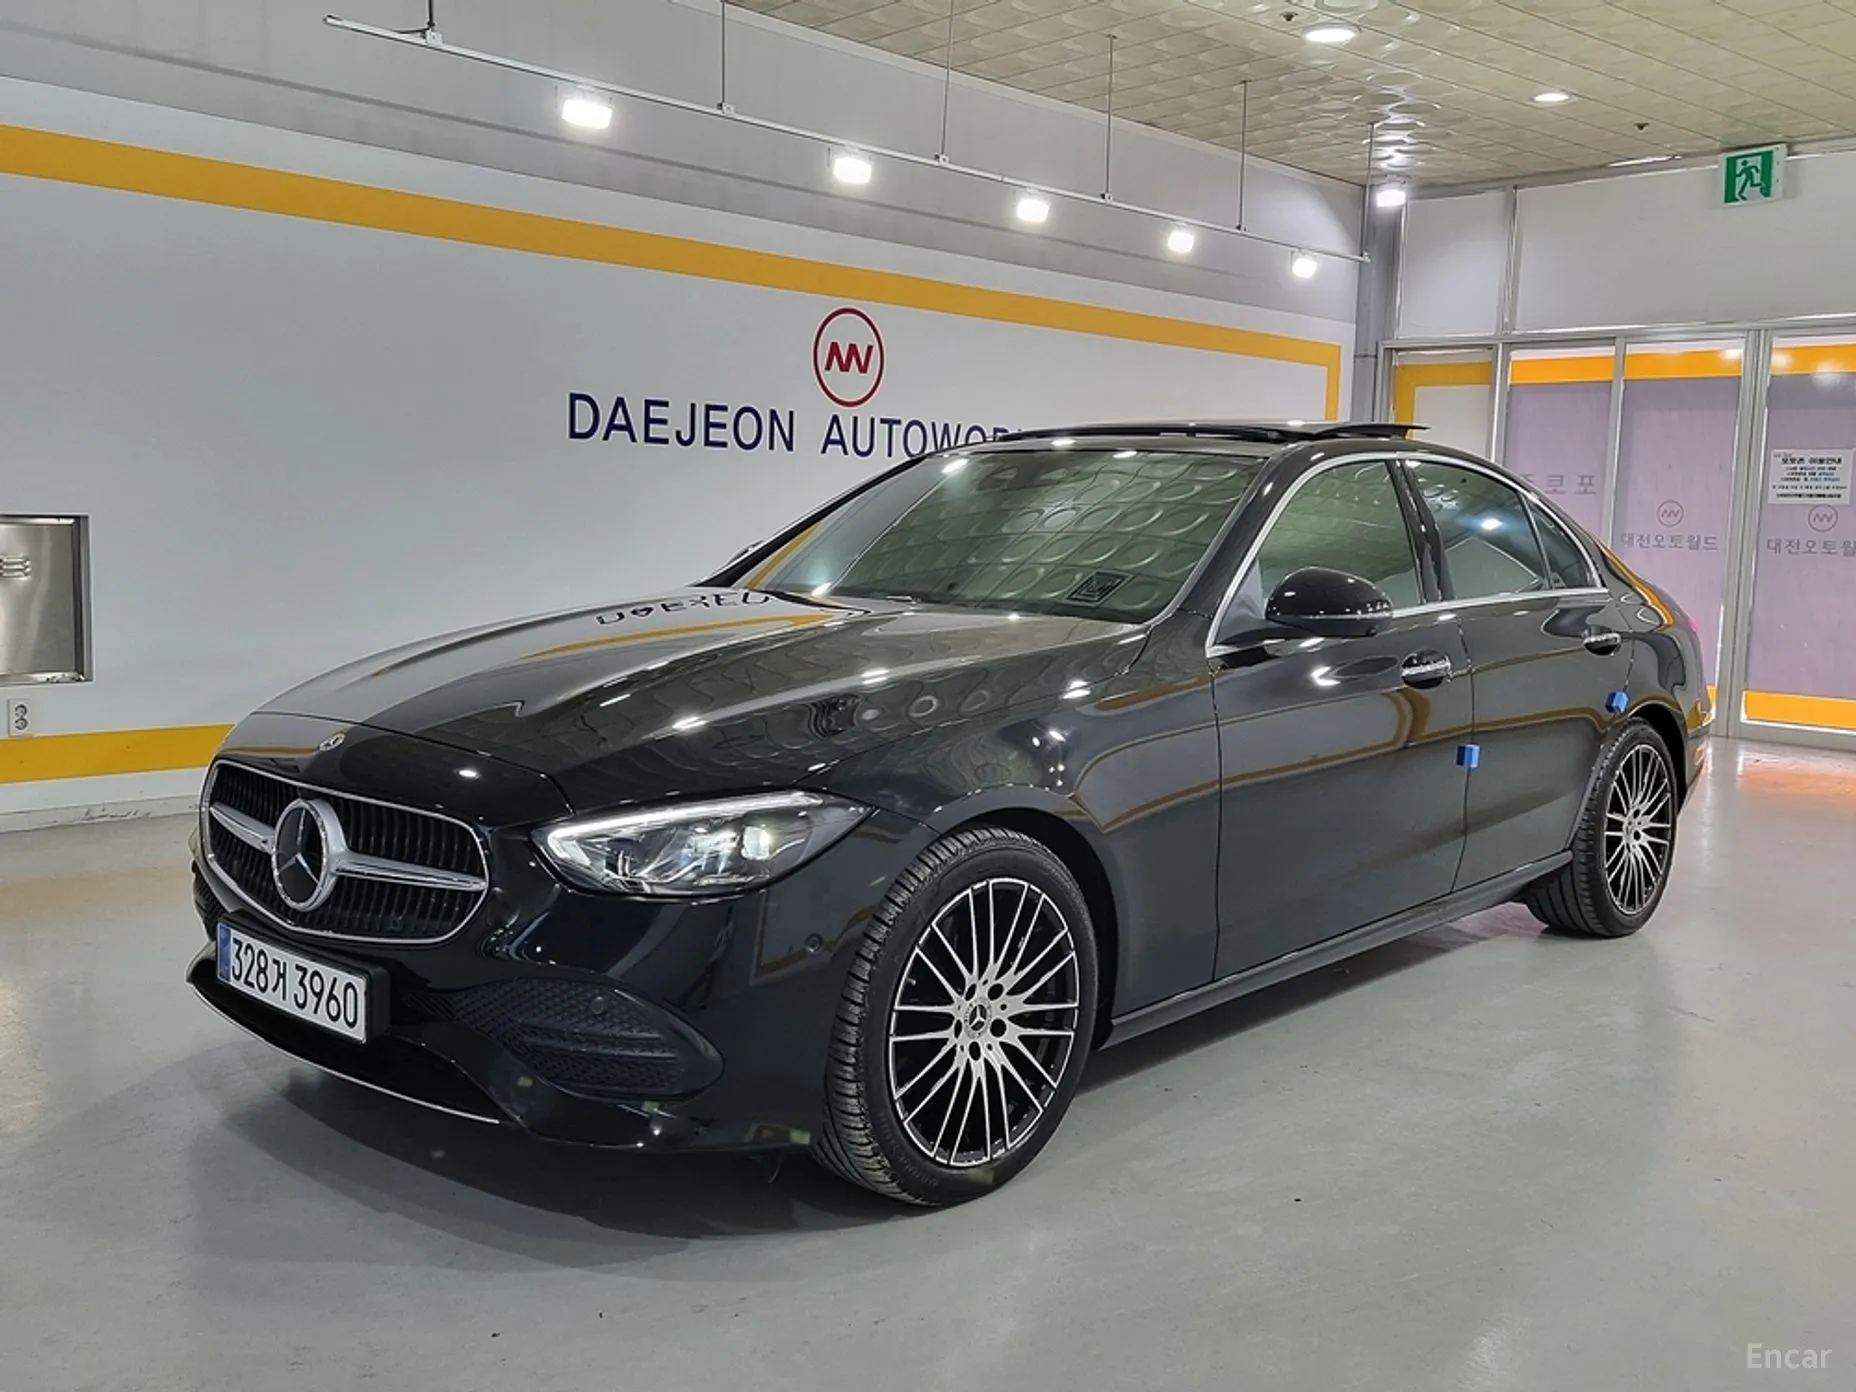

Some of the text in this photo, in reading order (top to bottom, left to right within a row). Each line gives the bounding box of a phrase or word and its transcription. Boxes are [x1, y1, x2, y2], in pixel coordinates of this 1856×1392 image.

[568, 392, 1021, 457] DAEJEON AUTOWO
[1620, 532, 1718, 551] 대전오토월드
[231, 937, 359, 1029] 328거 3960
